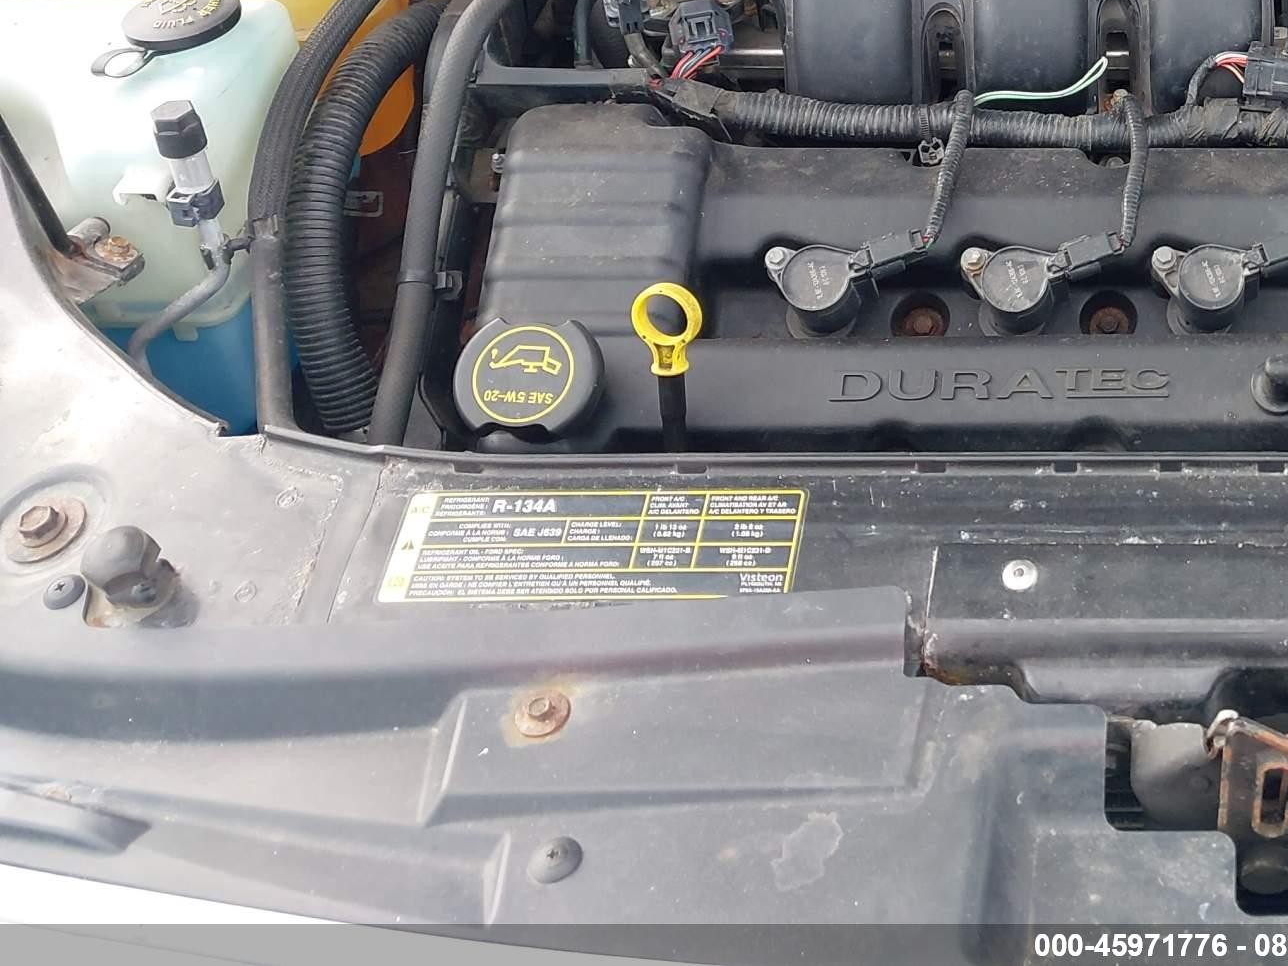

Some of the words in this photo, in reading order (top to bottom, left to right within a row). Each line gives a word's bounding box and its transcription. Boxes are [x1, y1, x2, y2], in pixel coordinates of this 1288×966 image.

[153, 16, 194, 29] FLUID
[828, 367, 1170, 402] DURATEC
[483, 389, 527, 403] 5W-20
[528, 391, 554, 405] SAE
[492, 498, 557, 513] R-134A
[513, 528, 535, 537] SAE
[537, 528, 562, 537] J639
[740, 573, 783, 582] Visteon
